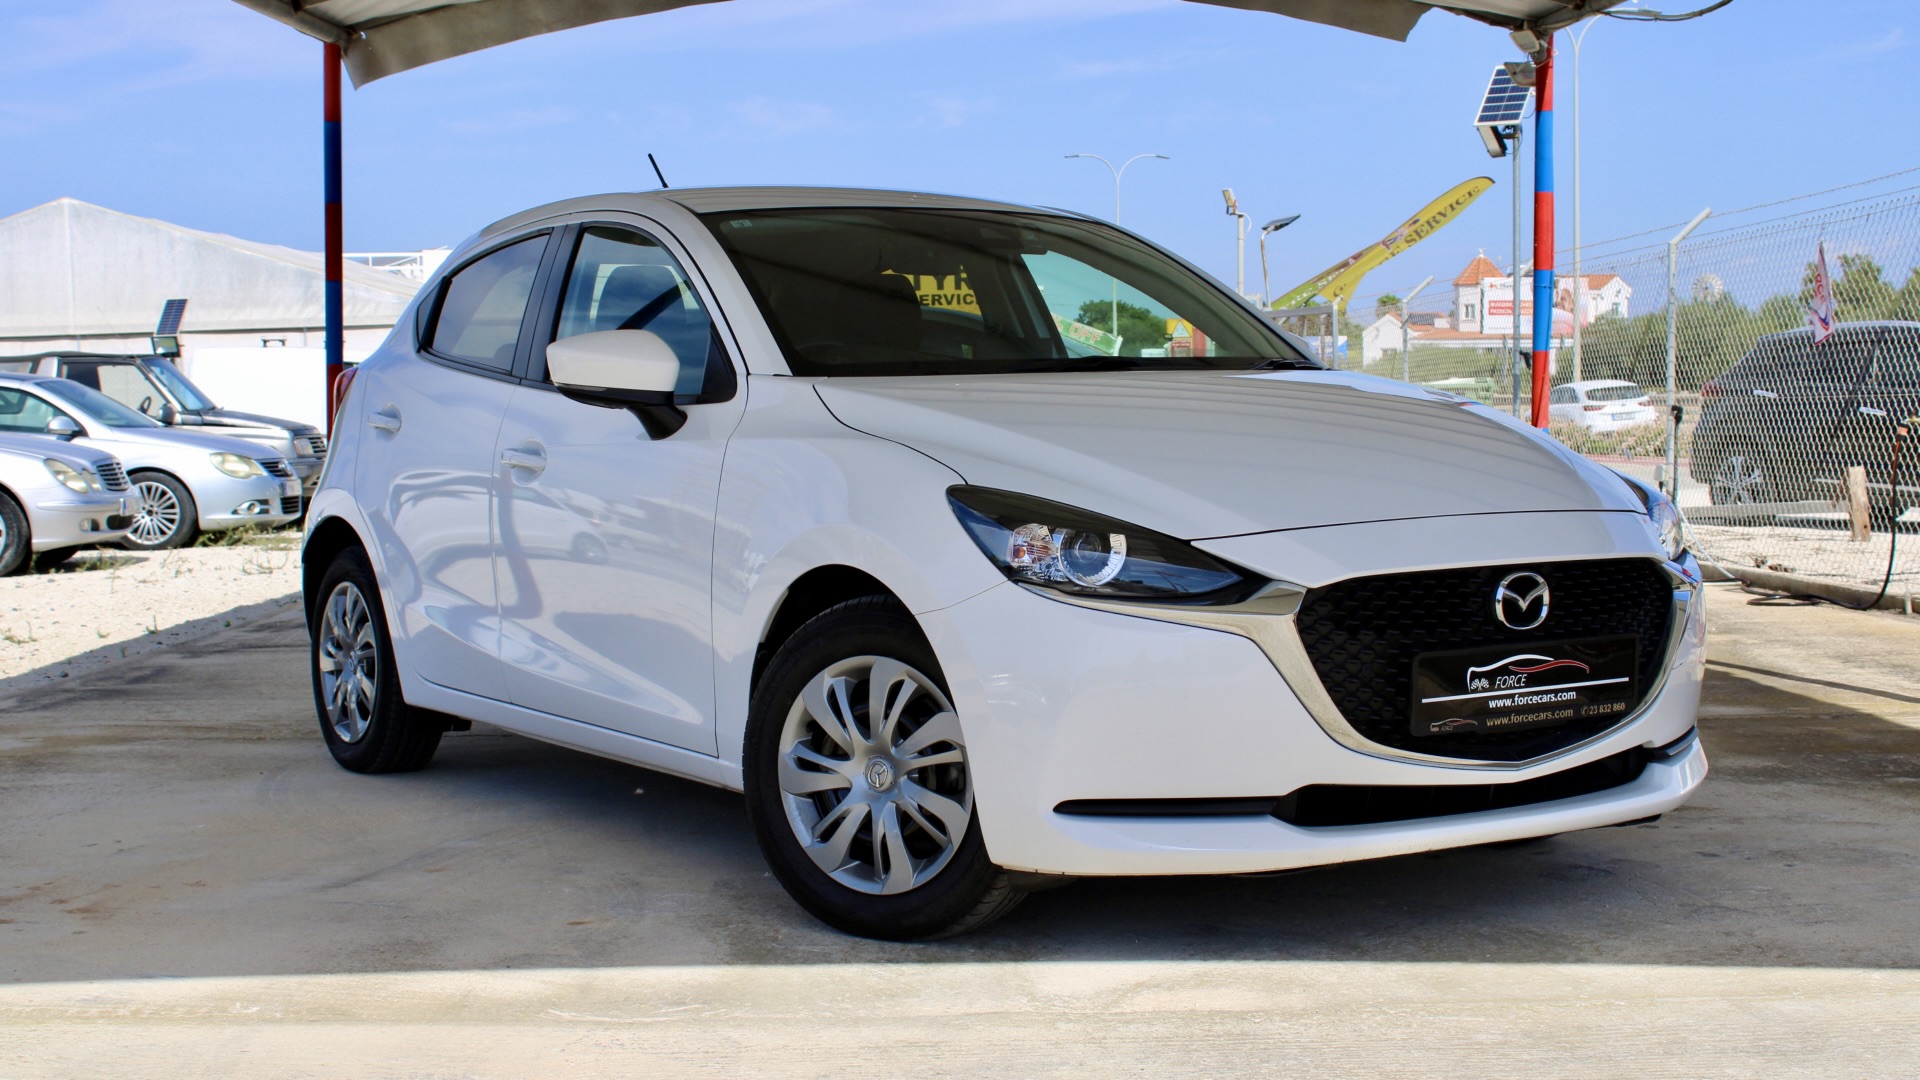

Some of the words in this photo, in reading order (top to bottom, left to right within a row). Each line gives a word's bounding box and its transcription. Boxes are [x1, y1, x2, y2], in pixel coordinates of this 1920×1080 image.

[1404, 186, 1480, 244] SERVICE
[919, 293, 978, 305] ERVIC
[1070, 323, 1103, 343] OFF
[1495, 674, 1527, 689] FORCE
[1488, 691, 1577, 708] www.forcecars.com
[1486, 709, 1574, 726] www.forcecars.com
[1589, 704, 1598, 715] 23
[1599, 703, 1612, 713] 832
